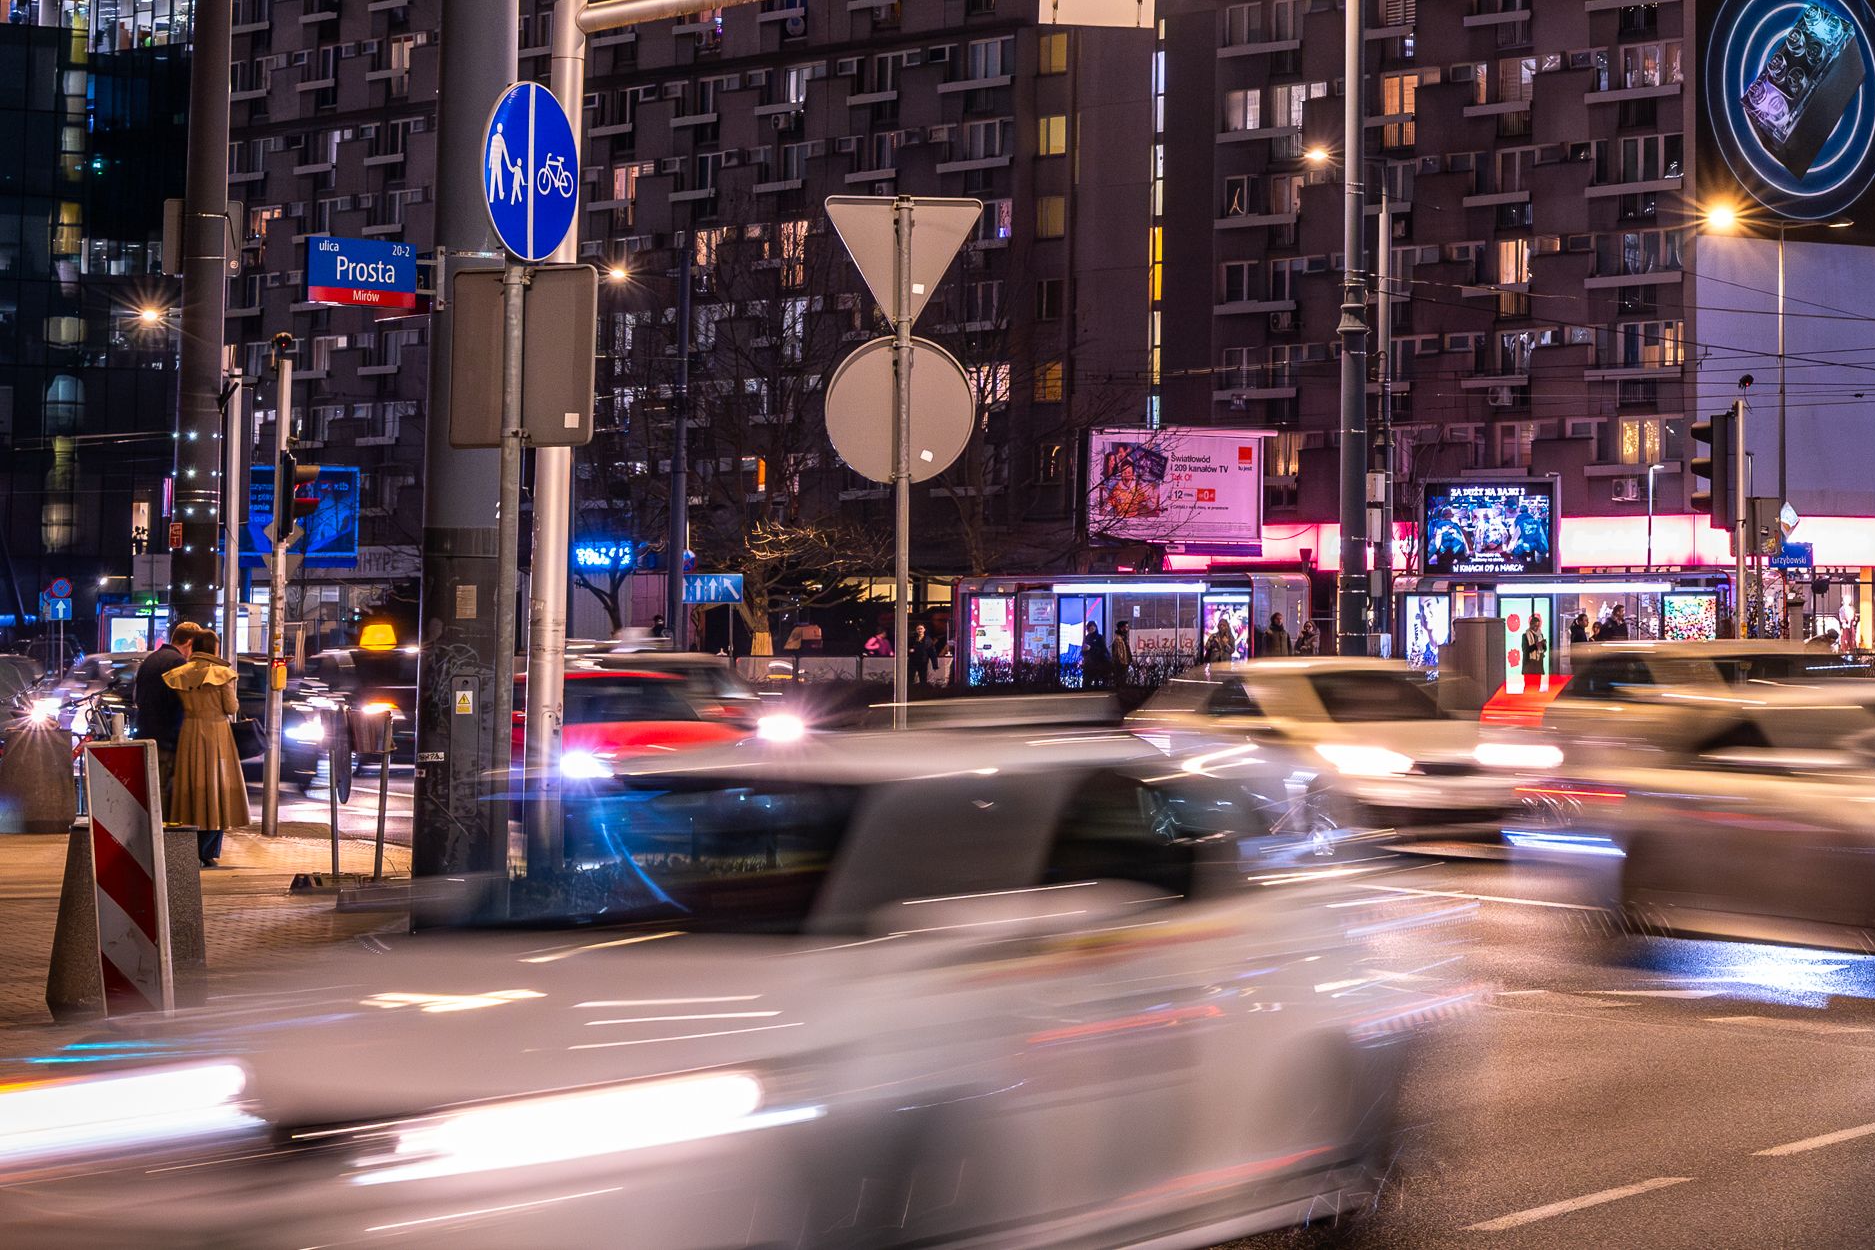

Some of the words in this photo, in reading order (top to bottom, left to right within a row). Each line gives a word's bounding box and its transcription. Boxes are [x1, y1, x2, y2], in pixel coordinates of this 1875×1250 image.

[319, 240, 339, 252] ulica
[392, 244, 410, 258] 20-2
[336, 256, 395, 284] Prosta
[352, 290, 380, 302] Mirów
[1174, 463, 1188, 472] 209
[1219, 465, 1229, 473] TV
